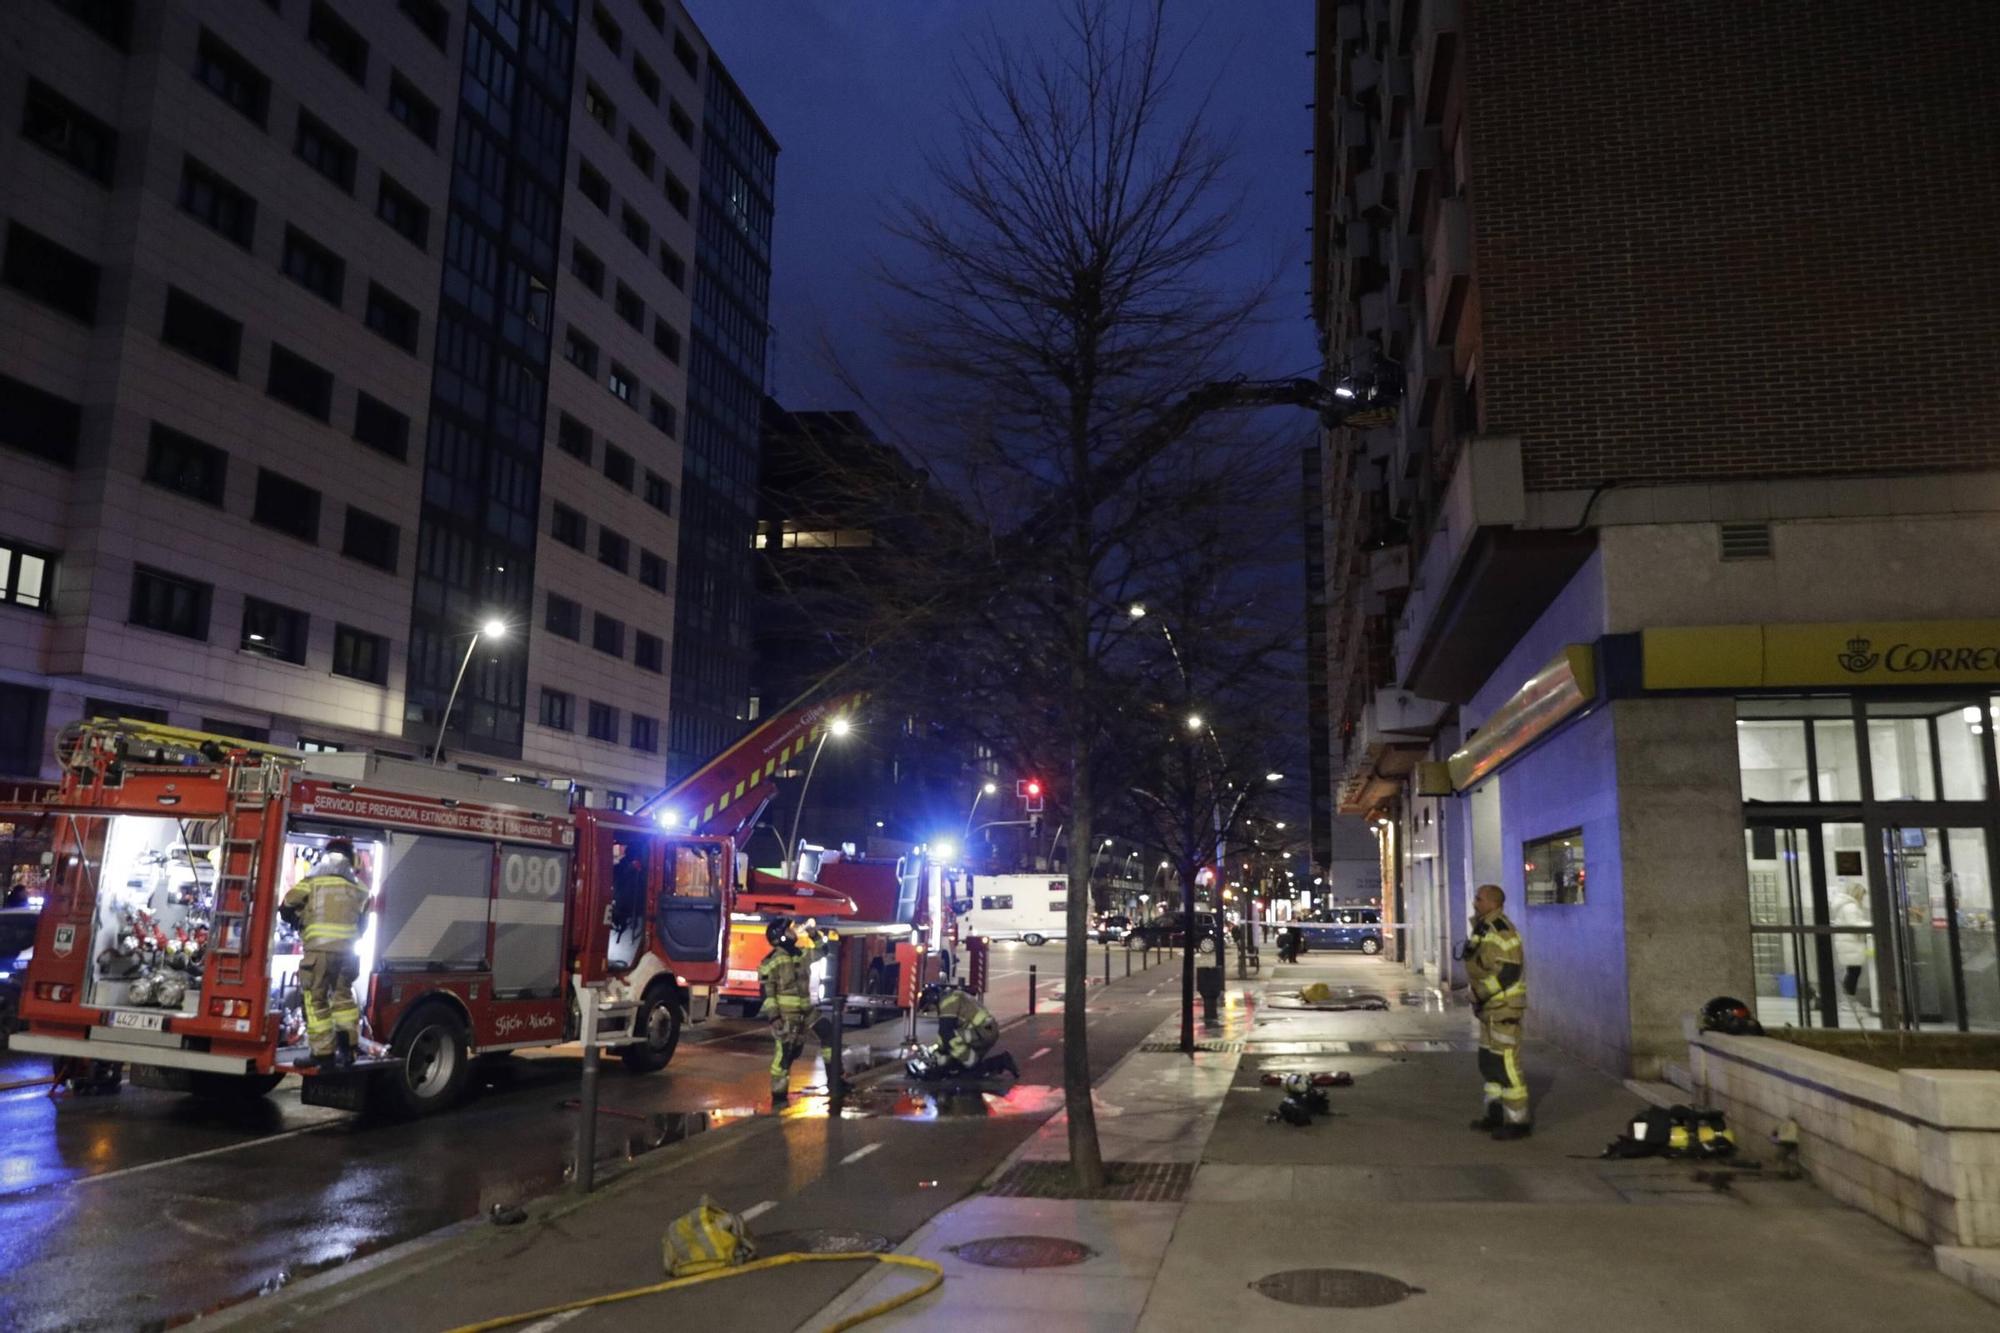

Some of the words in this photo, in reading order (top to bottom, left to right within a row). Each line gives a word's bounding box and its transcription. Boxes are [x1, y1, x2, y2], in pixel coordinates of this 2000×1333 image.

[1886, 643, 2000, 673] CORRE
[314, 795, 354, 812] SERVICIO
[355, 801, 368, 814] DE
[369, 802, 419, 821] PREVENCIÓN,
[459, 816, 470, 828] DE
[505, 853, 561, 896] 080
